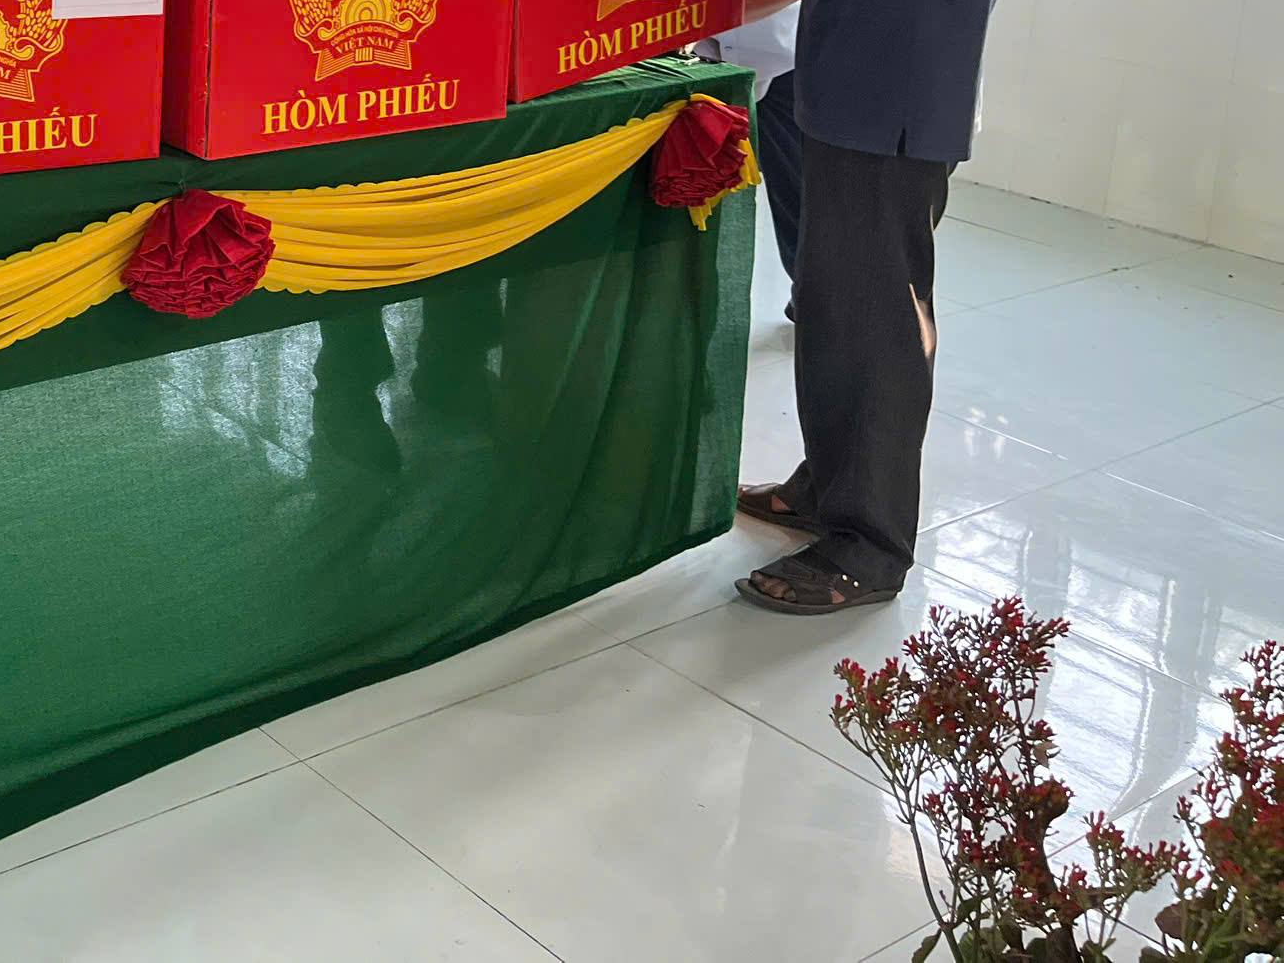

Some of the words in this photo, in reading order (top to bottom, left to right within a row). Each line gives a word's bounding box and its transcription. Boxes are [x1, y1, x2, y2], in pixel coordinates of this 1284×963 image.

[557, 27, 623, 74] HÒM
[630, 0, 708, 50] PHIẾU
[262, 89, 348, 134] HÒM
[357, 73, 460, 121] PHIẾU
